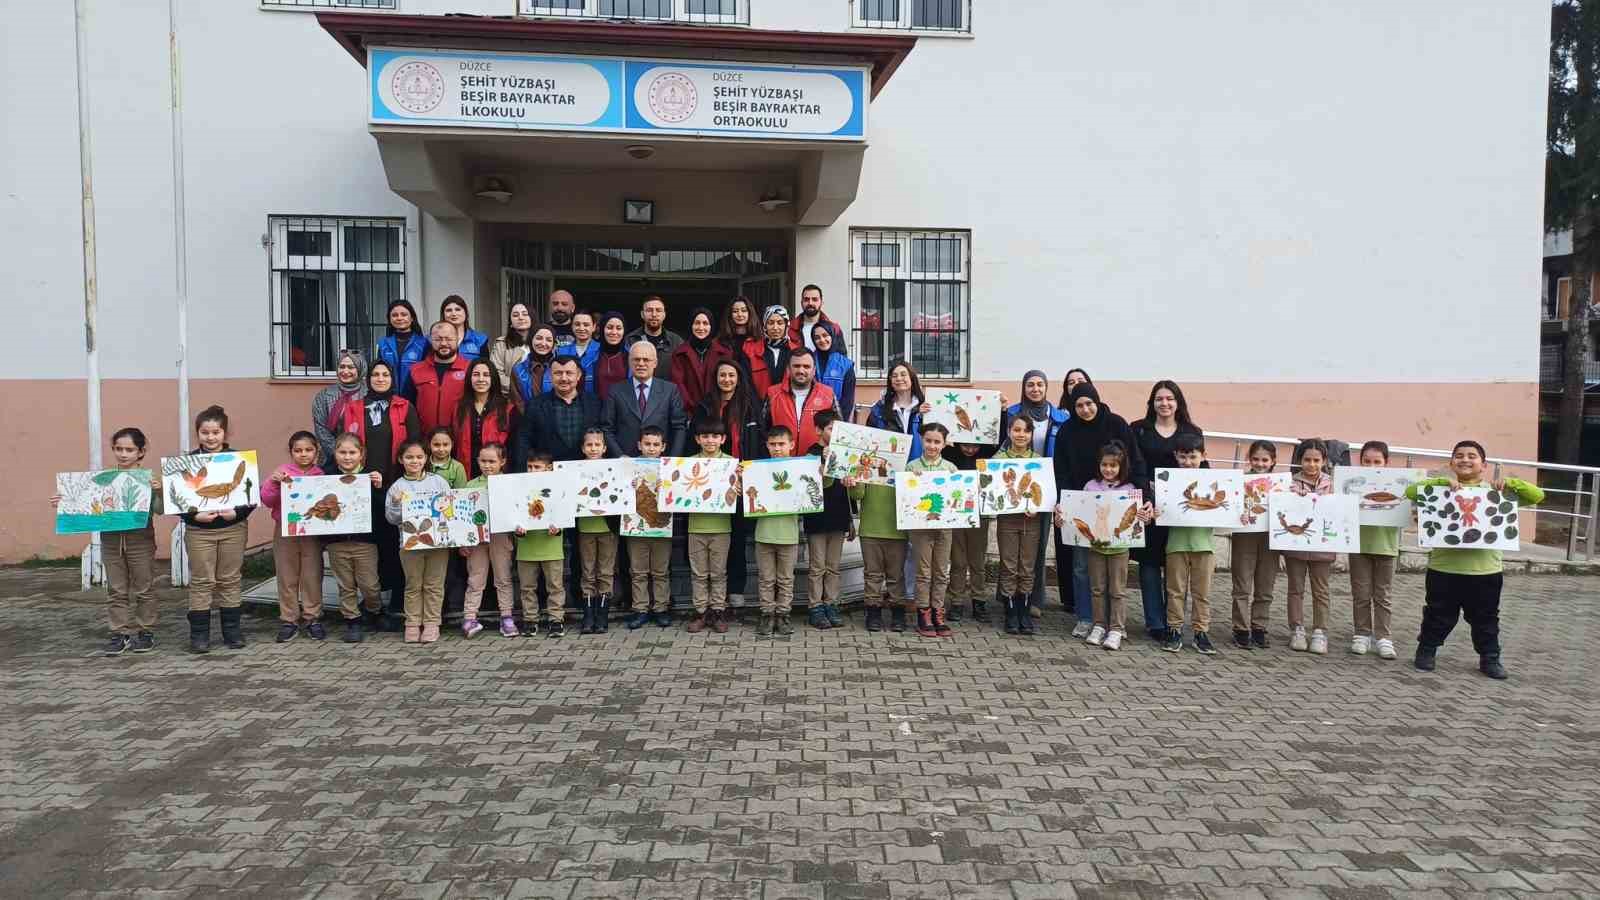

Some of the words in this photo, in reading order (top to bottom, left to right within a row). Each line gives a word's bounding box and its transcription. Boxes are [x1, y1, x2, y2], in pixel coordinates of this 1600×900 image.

[460, 61, 492, 72] DÜZCE
[460, 74, 496, 89] ŞEHİT
[501, 76, 555, 90] YÜZBAŞI
[713, 72, 743, 82] DÜZCE
[461, 90, 497, 104] BEŞİR
[501, 93, 576, 105] BAYRAKTAR
[713, 86, 748, 99] ŞEHİT
[751, 85, 803, 100] YÜZBAŞI
[461, 104, 525, 118] İLKOKULU
[713, 101, 747, 114] BEŞİR
[751, 103, 821, 114] BAYRAKTAR
[713, 116, 788, 128] ORTAOKULU
